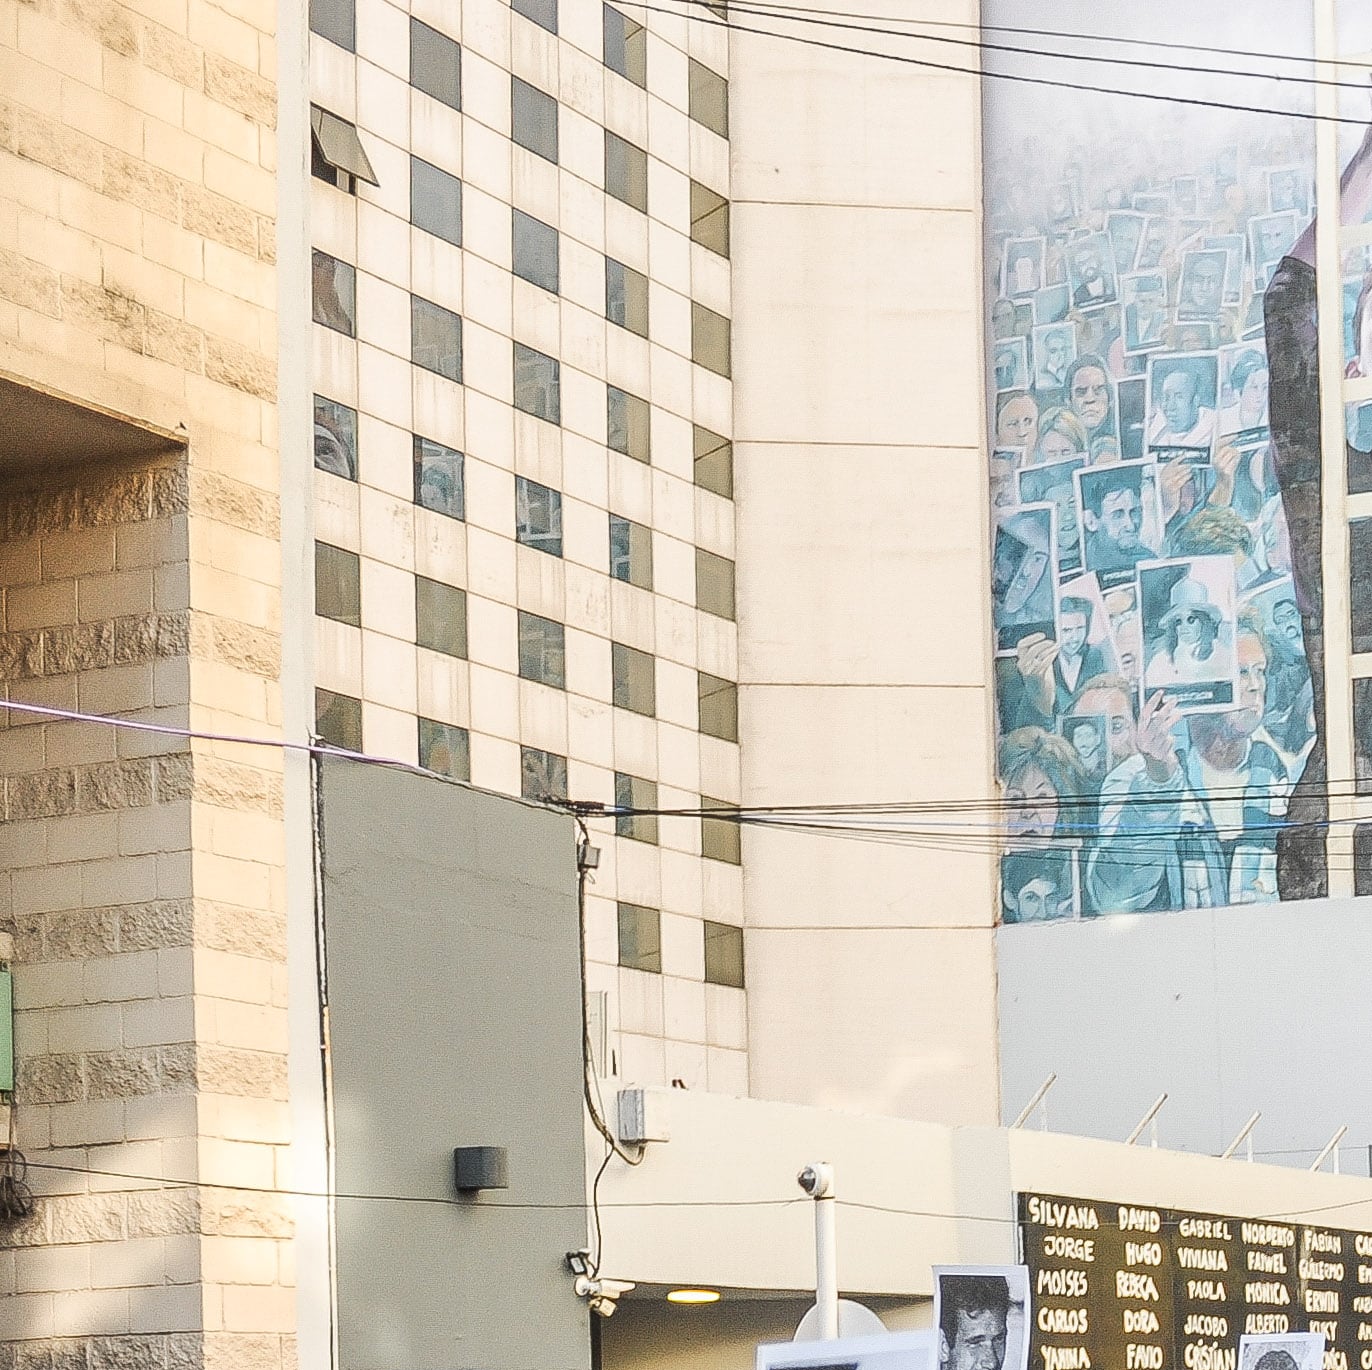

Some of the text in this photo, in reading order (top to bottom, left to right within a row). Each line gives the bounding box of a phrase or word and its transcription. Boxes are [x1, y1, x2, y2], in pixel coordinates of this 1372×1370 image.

[1028, 1196, 1099, 1230] SILVANA
[1118, 1206, 1161, 1233] DAVID
[1179, 1218, 1232, 1241] GABRIEL
[1043, 1235, 1095, 1262] JORGE
[1125, 1242, 1162, 1266] HUGO
[1177, 1247, 1228, 1272] VIVIANA
[1037, 1269, 1088, 1297] MOISES
[1187, 1280, 1226, 1302] PAOLA
[1245, 1281, 1290, 1306] MONICA
[1305, 1289, 1339, 1313] ERWIN
[1037, 1306, 1089, 1334] CARLOS
[1124, 1309, 1160, 1334] DORA
[1184, 1314, 1228, 1337] JACOBO
[1245, 1313, 1289, 1334] ALBERTO
[1126, 1343, 1163, 1370] FAVIO
